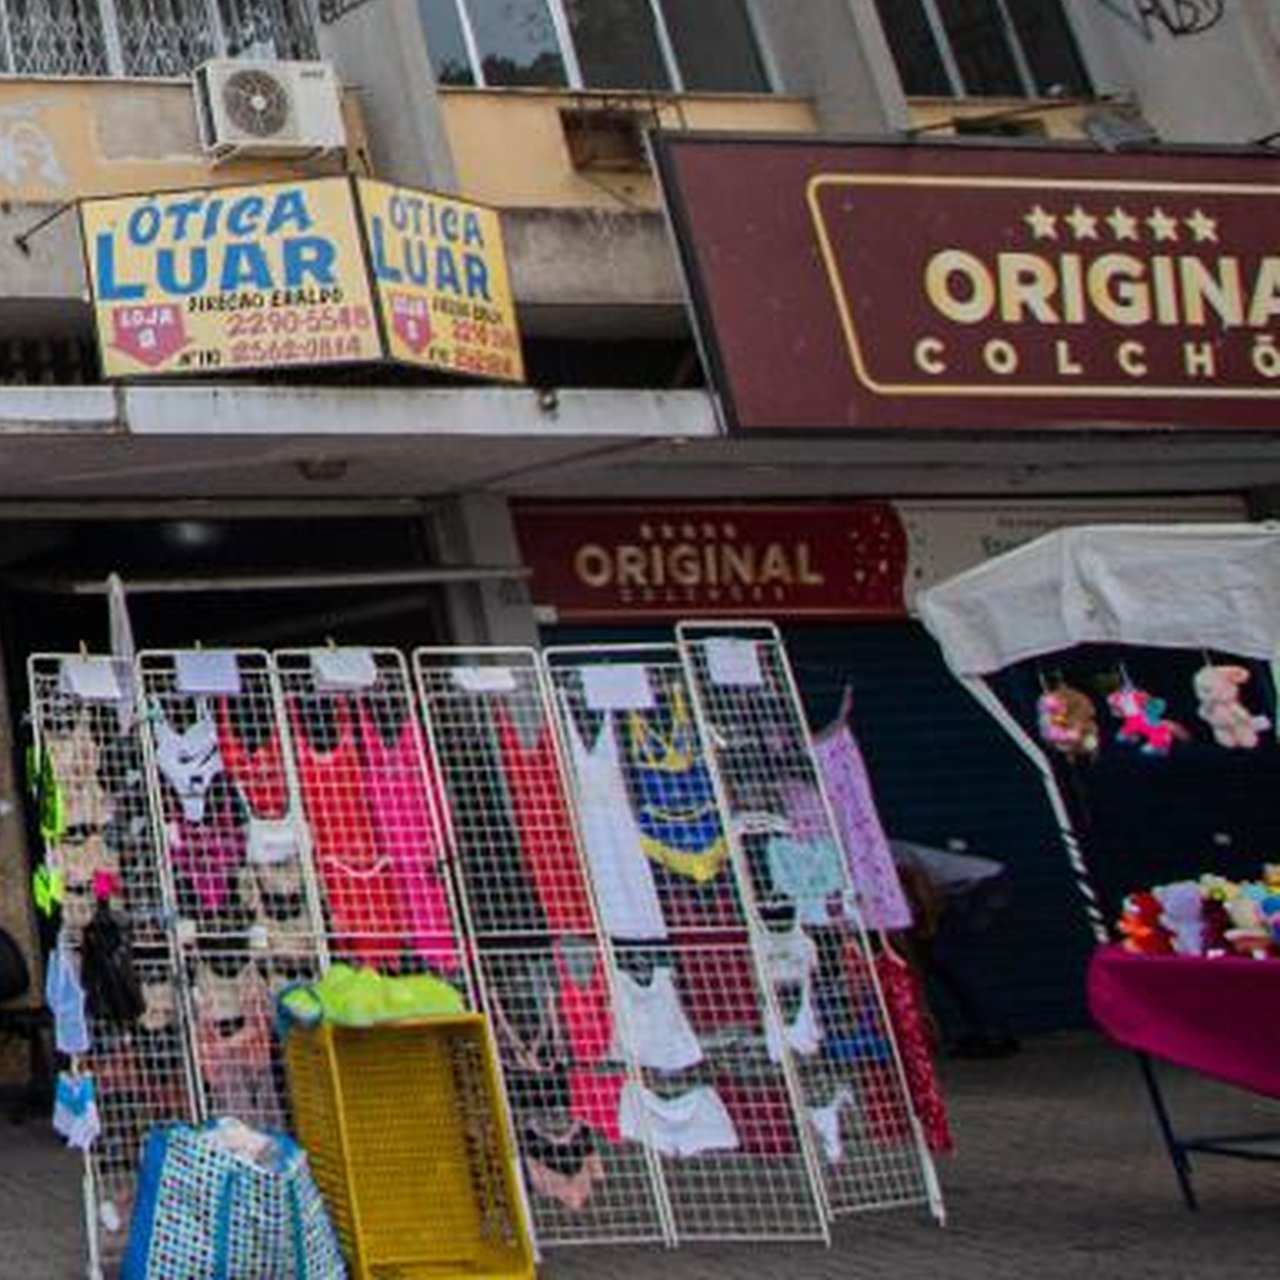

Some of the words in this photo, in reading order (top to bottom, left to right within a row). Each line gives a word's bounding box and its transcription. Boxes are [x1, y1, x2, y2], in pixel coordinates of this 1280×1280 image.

[96, 234, 337, 301] LUAR
[373, 216, 493, 304] LUAR
[574, 542, 825, 588] ORIGINAL
